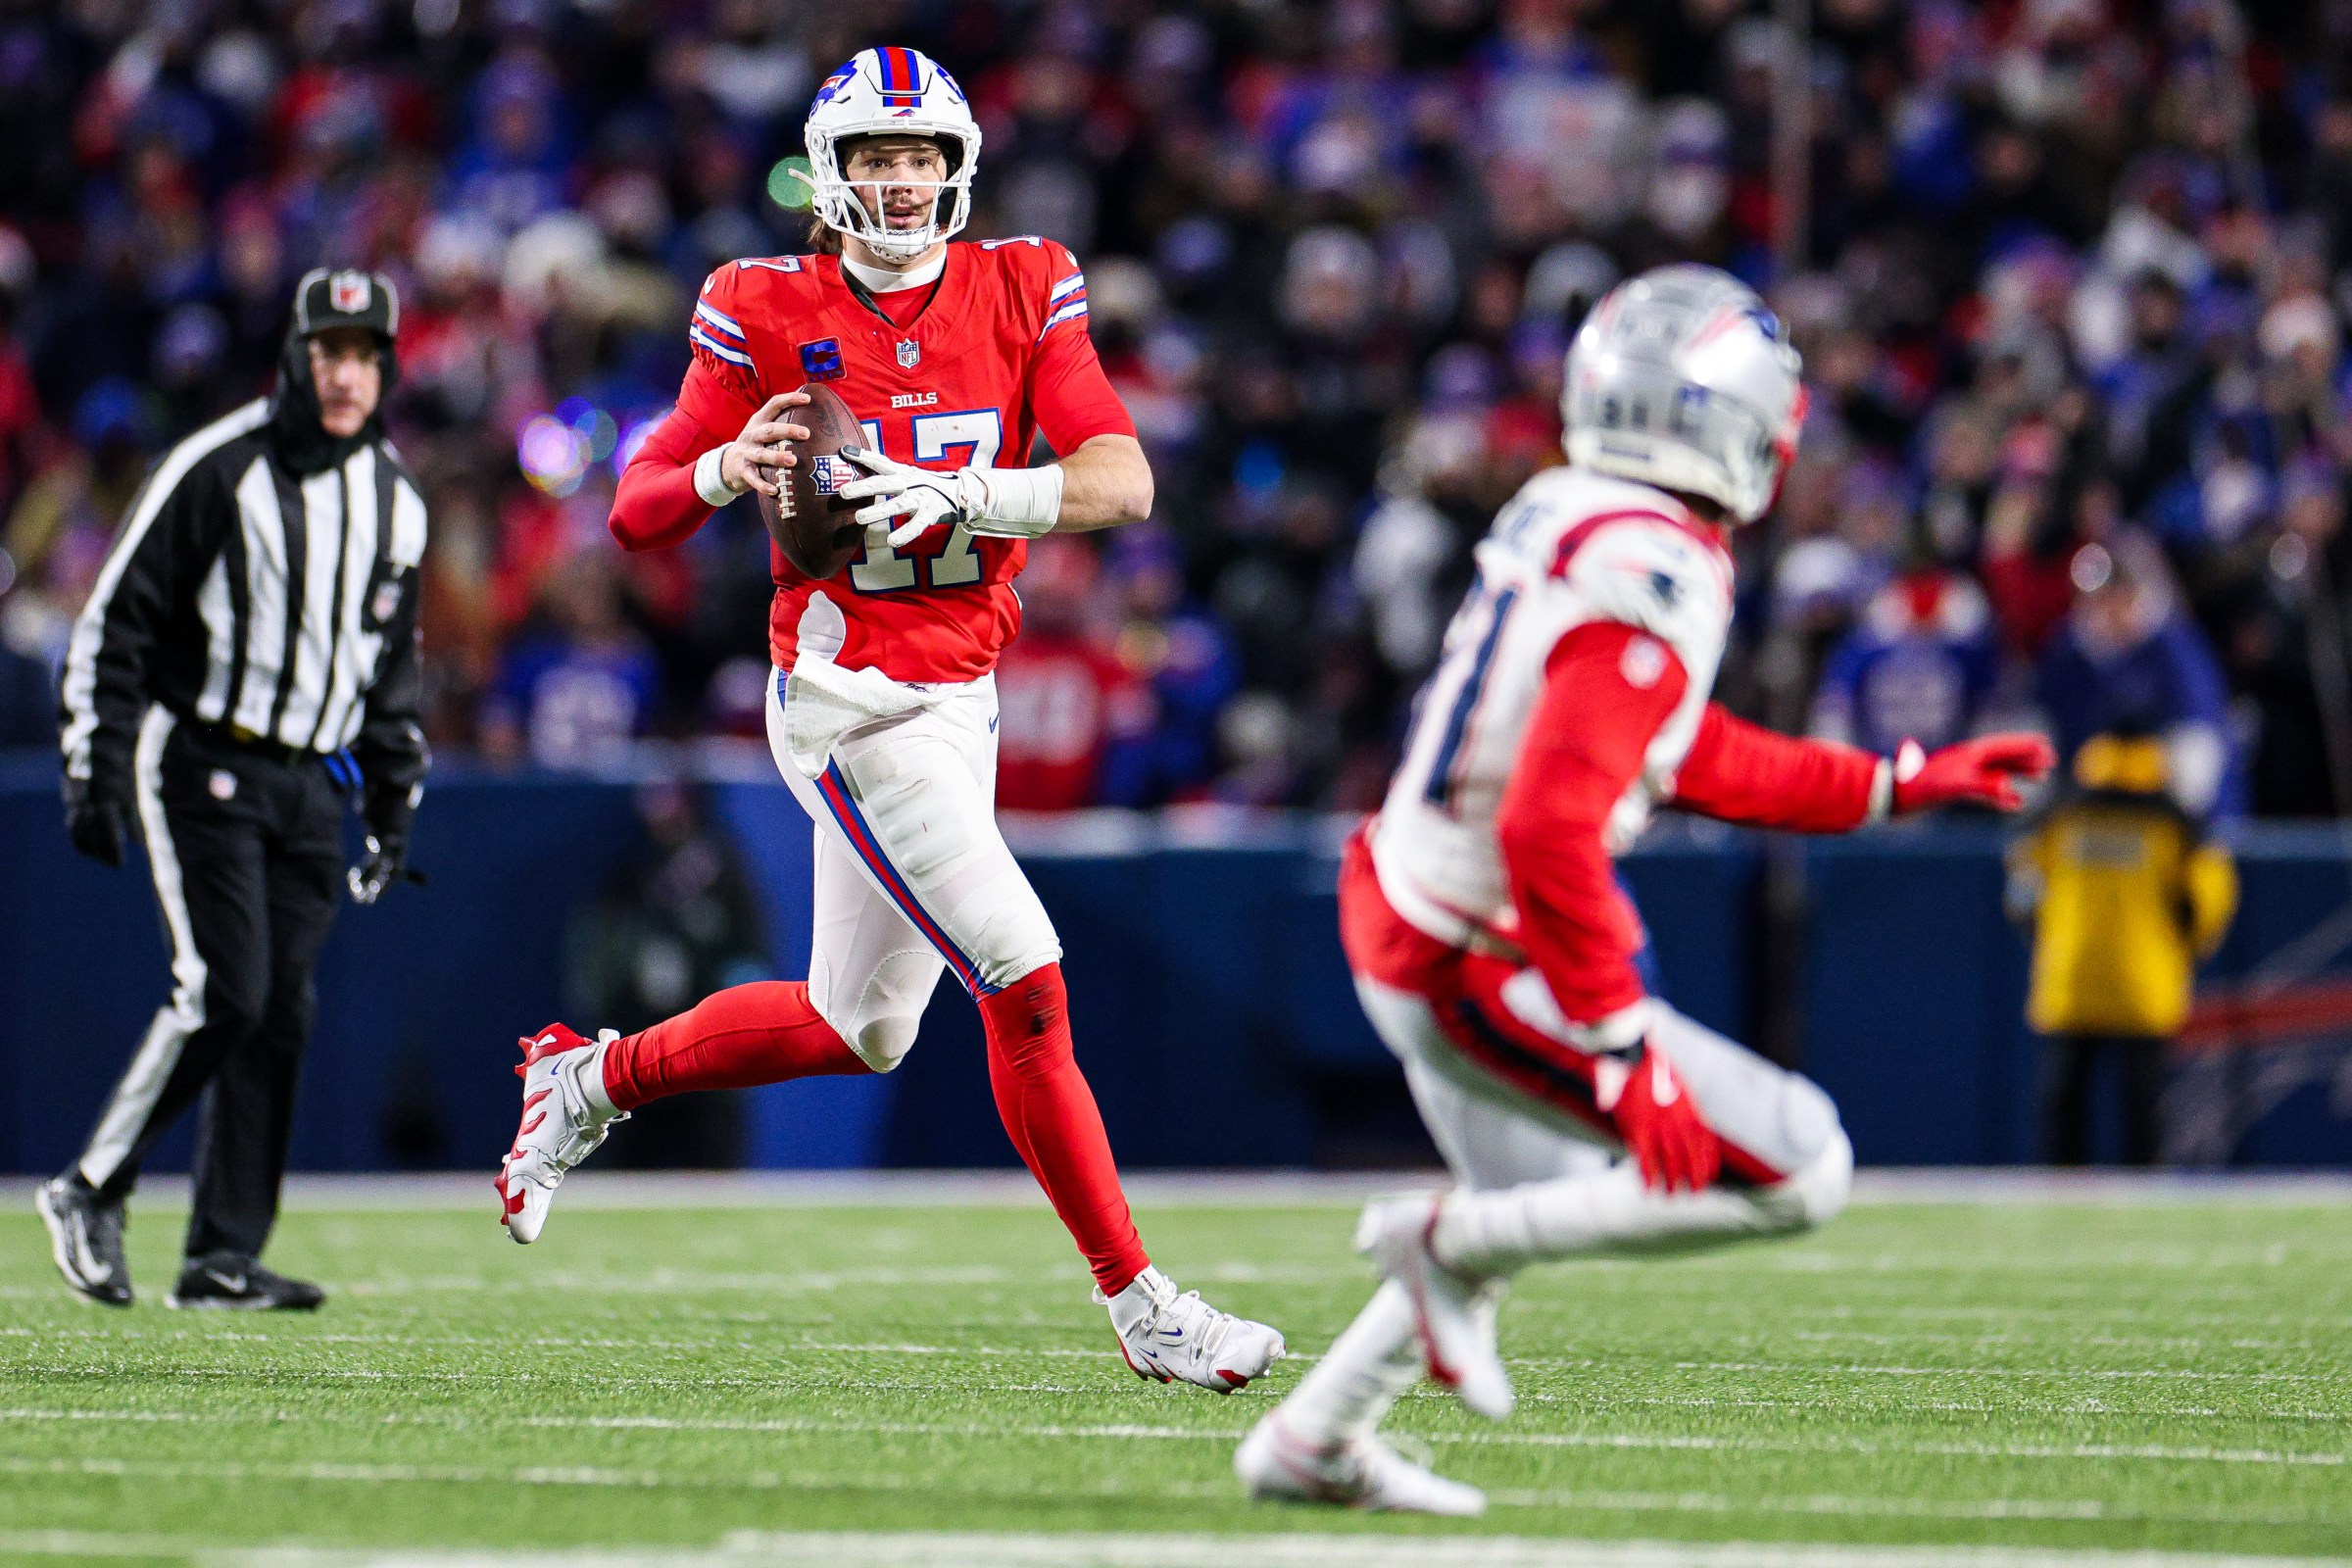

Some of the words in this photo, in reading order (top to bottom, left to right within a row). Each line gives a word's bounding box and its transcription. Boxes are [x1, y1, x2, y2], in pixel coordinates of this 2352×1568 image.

[801, 340, 840, 374] C
[901, 352, 916, 364] NFL
[890, 391, 939, 409] BILLS
[849, 408, 1004, 594] 17
